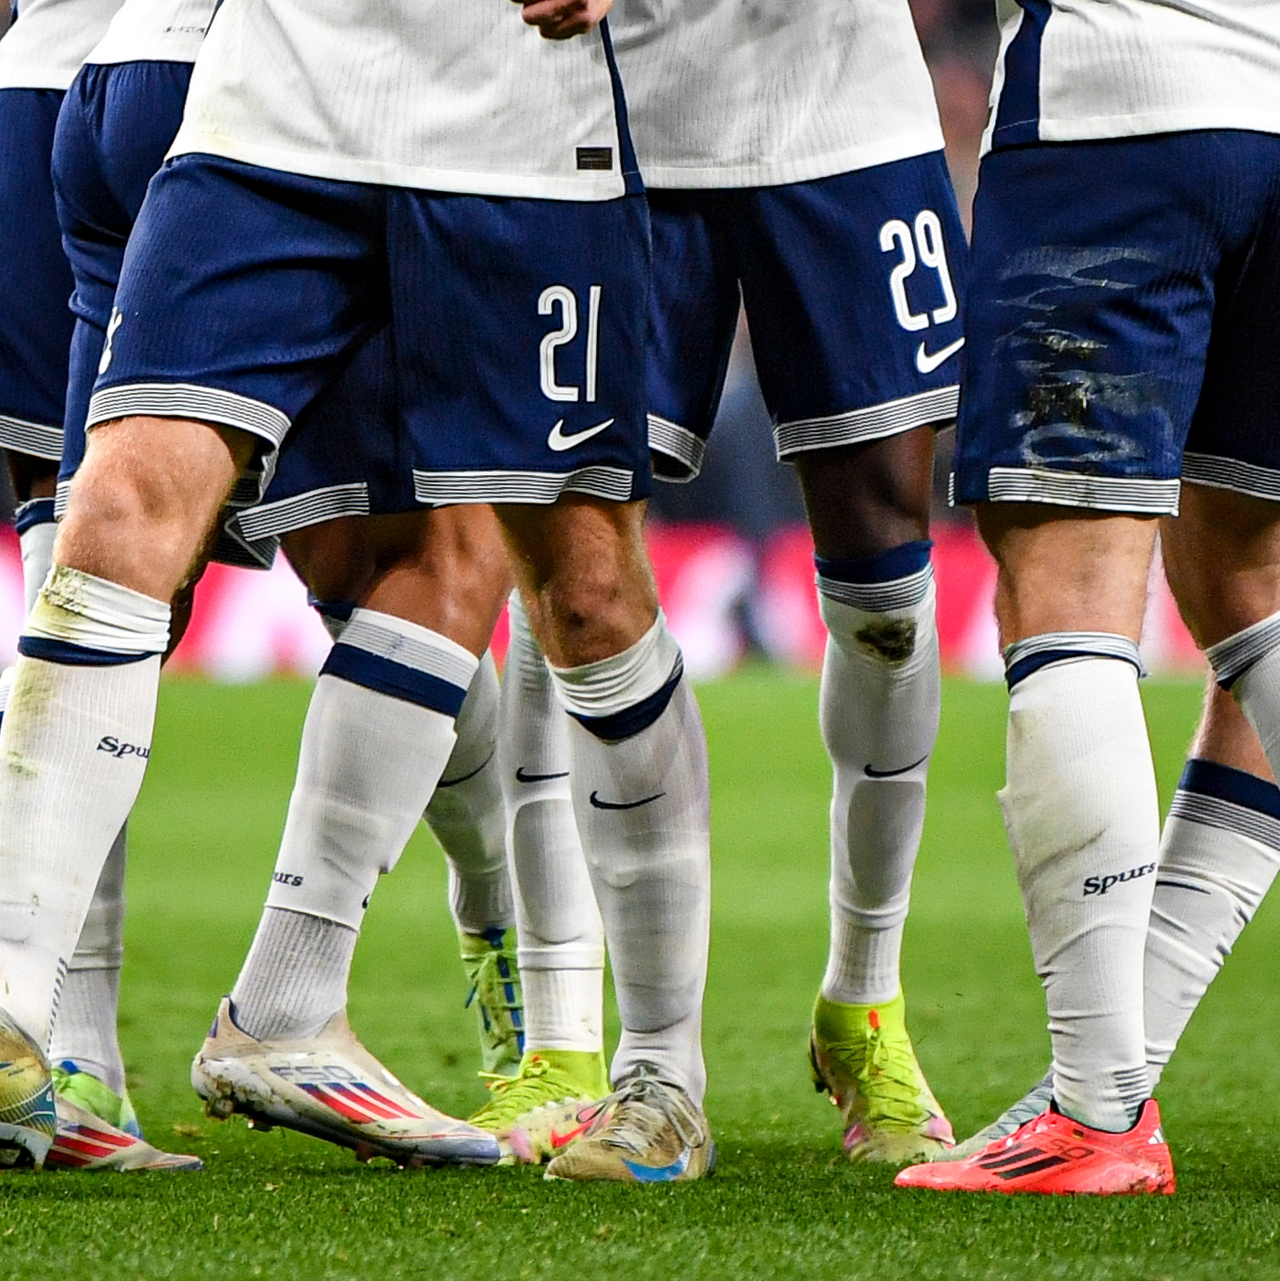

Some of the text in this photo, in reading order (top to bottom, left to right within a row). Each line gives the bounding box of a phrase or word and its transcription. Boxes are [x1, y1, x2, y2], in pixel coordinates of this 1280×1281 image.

[879, 210, 958, 331] 29
[537, 285, 601, 402] 21
[96, 735, 150, 759] Spu
[273, 872, 304, 887] urs
[1082, 862, 1156, 896] Spurs
